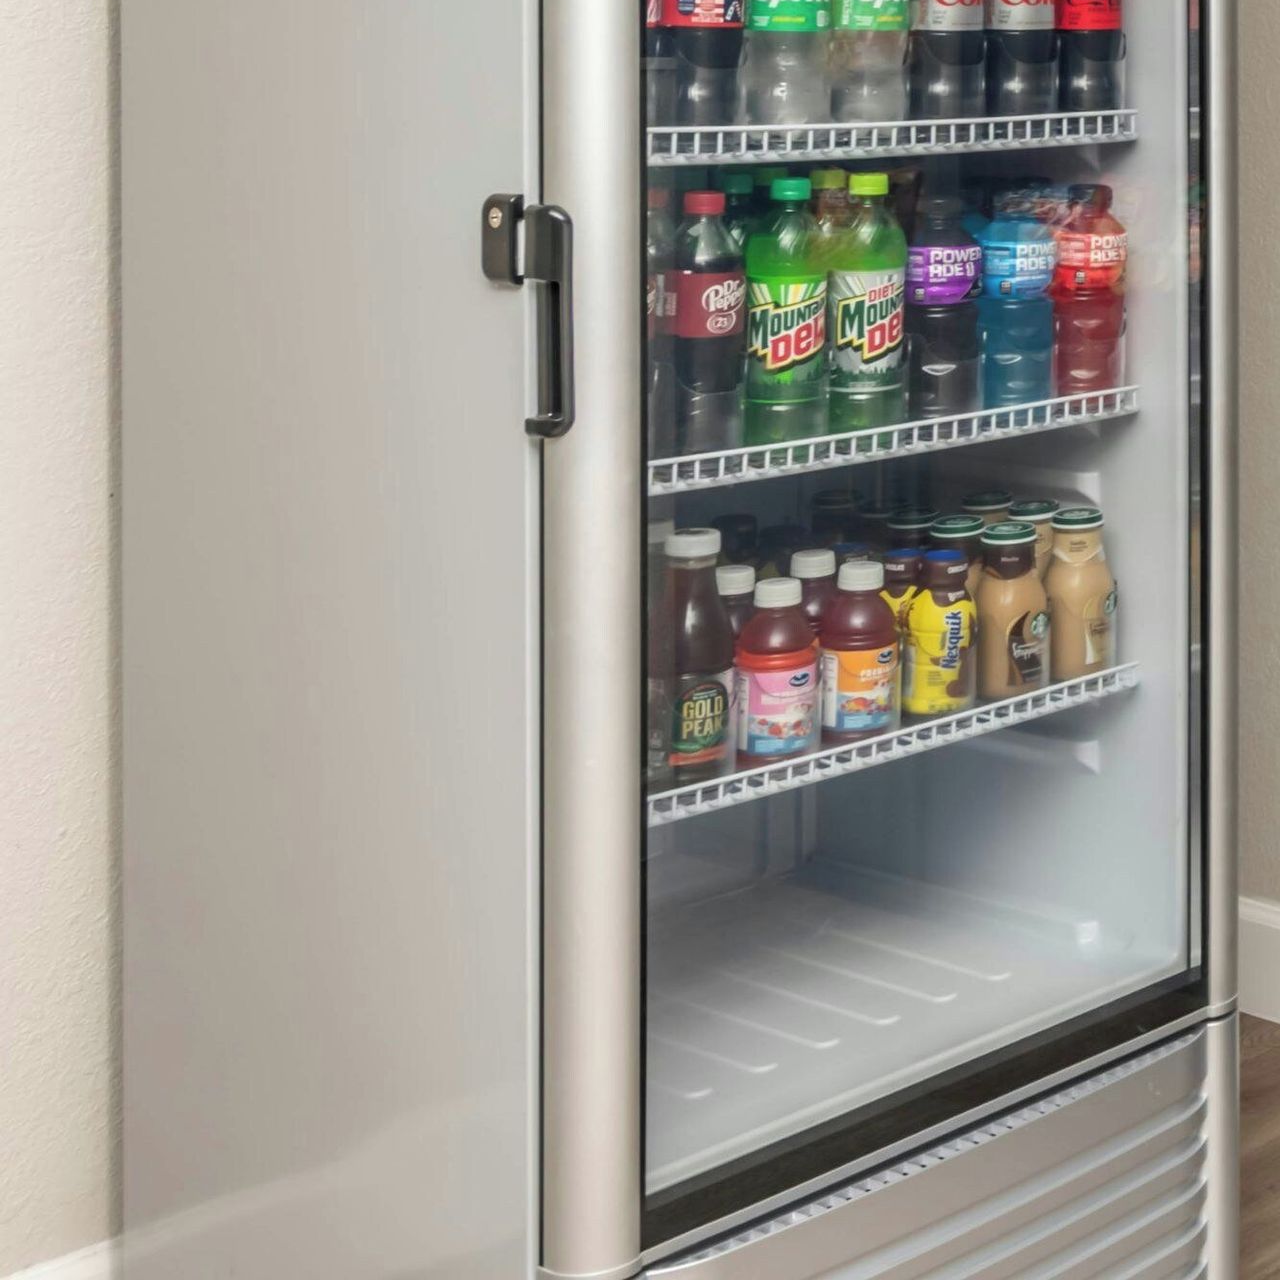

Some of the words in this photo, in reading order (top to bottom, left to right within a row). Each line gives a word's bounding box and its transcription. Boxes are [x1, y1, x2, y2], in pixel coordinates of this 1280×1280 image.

[929, 263, 965, 277] ADE
[723, 279, 740, 296] Dr
[868, 283, 897, 303] DIET
[941, 610, 962, 669] Nesquik
[682, 695, 723, 720] GOLD
